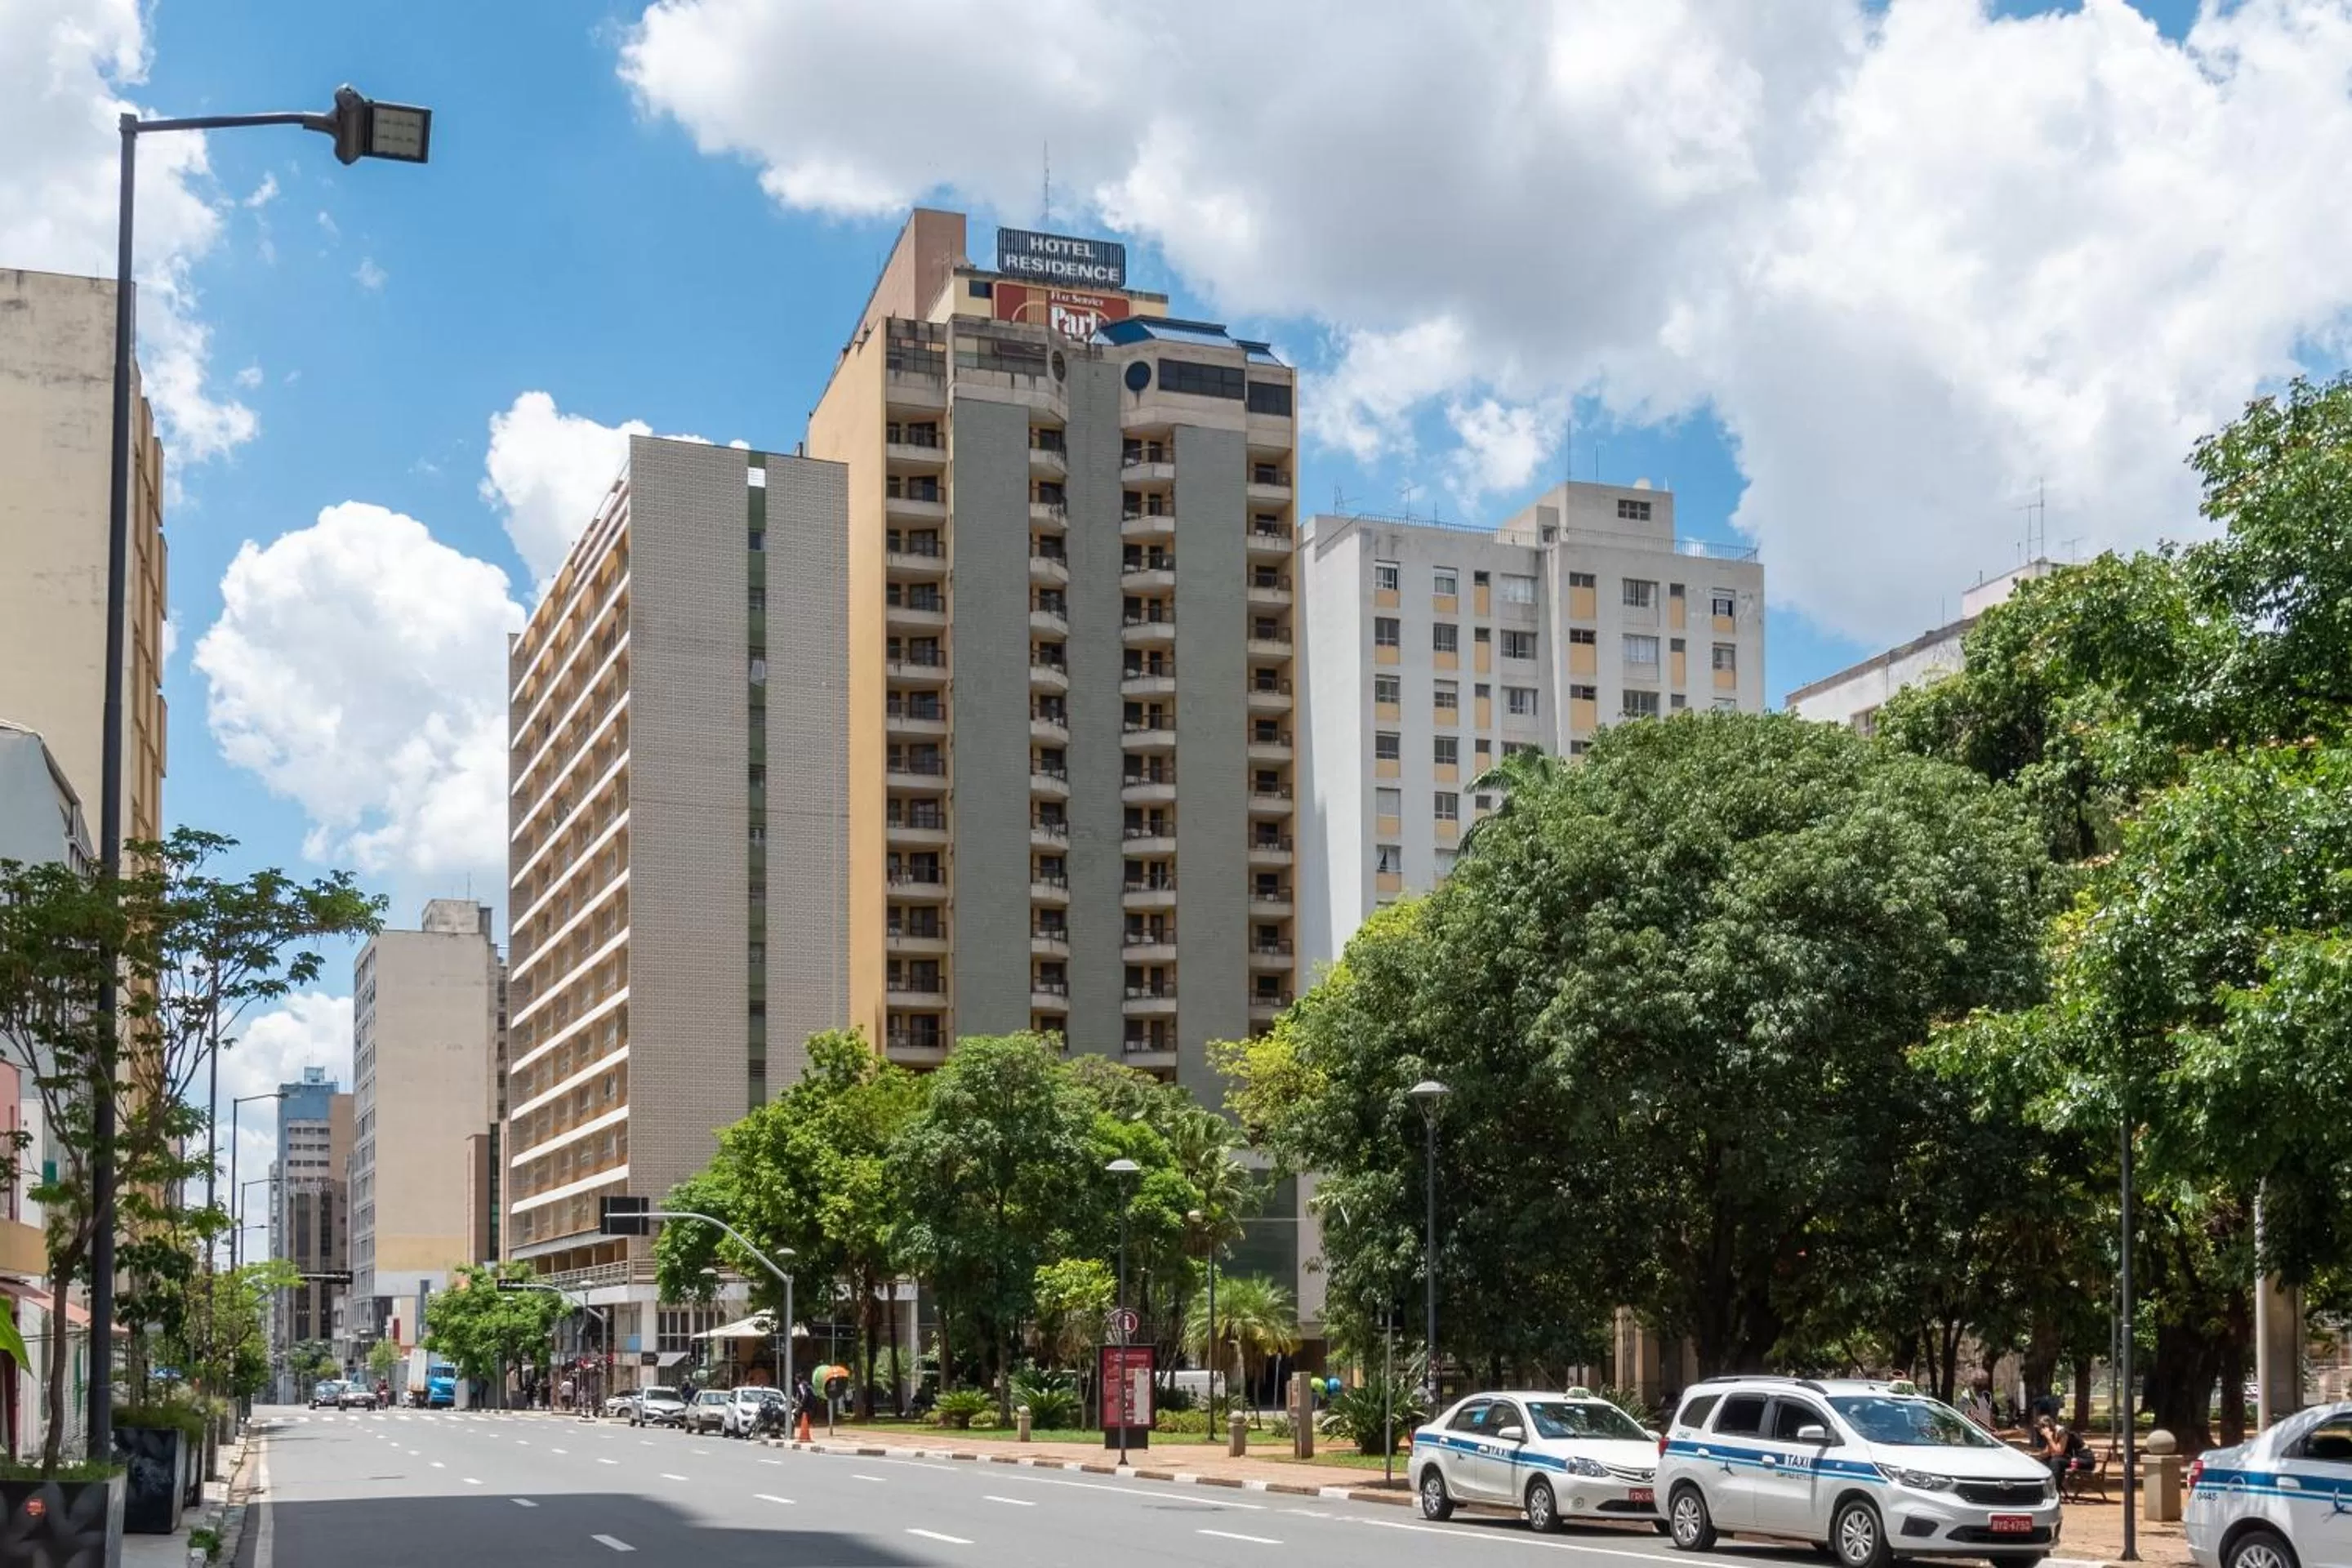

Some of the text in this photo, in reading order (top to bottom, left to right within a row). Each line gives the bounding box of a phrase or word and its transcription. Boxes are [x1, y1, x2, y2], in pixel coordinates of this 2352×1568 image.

[1030, 236, 1095, 258] HOTEL
[1006, 254, 1119, 282] RESIDENCE
[1787, 1454, 1810, 1468] TAXI
